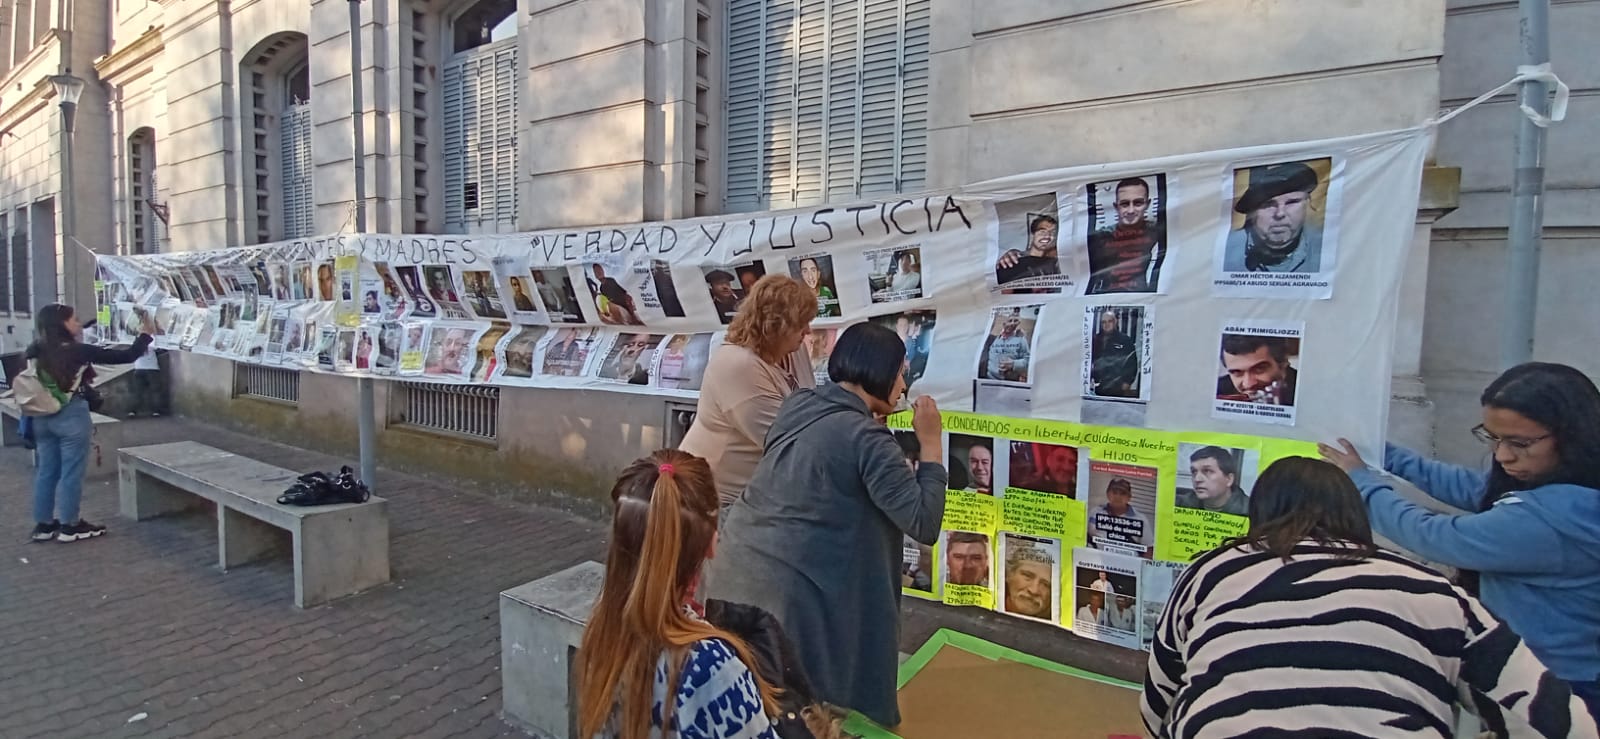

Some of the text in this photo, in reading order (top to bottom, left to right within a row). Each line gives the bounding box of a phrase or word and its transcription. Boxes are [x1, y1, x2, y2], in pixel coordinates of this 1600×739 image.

[358, 237, 368, 263] Y
[375, 237, 477, 265] MADRES
[700, 222, 726, 256] Y
[732, 195, 972, 256] JUSTICIA
[1247, 327, 1299, 335] TRIMIGLIOZZI
[947, 415, 1010, 434] CONDENADOS
[1014, 425, 1031, 434] en
[1138, 438, 1175, 452] Nuestros
[1103, 449, 1138, 462] HIJOS
[1097, 522, 1113, 531] Salió
[1123, 527, 1141, 536] sierra
[1174, 536, 1200, 546] SEXUAL
[1078, 561, 1105, 570] GUSTAVO
